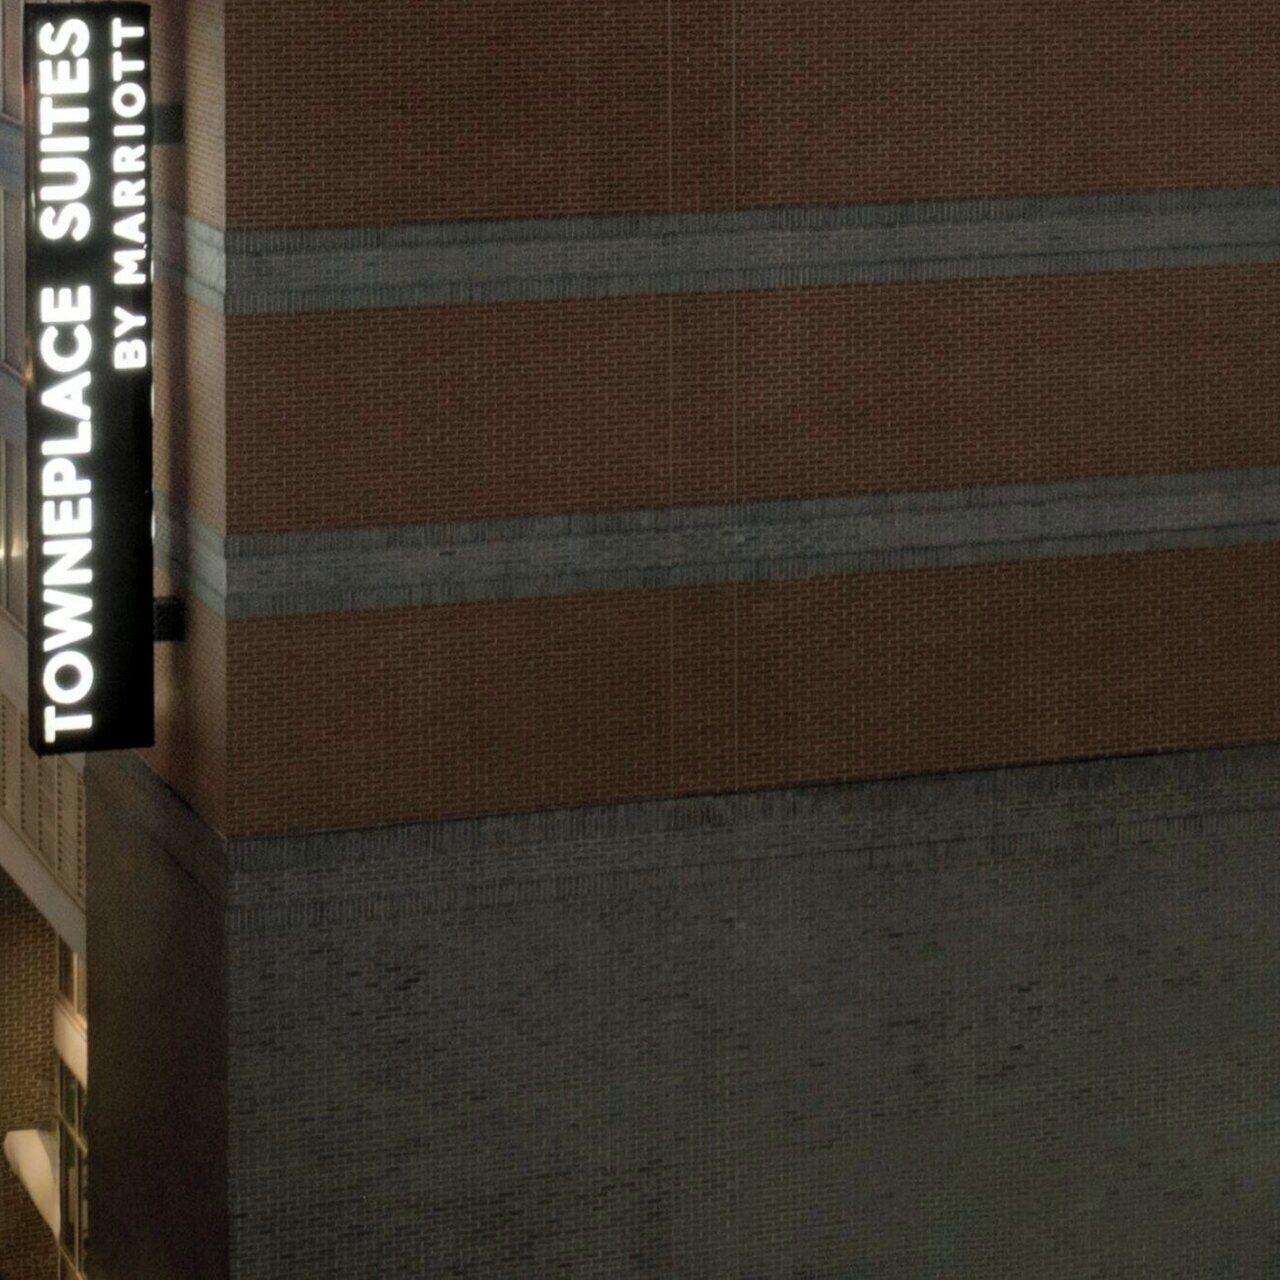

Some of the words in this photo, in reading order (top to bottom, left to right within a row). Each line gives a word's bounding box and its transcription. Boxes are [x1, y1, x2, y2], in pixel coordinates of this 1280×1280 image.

[36, 17, 93, 242] SUITES
[110, 16, 148, 286] MARRIOTT
[111, 305, 148, 371] BY
[38, 283, 95, 744] TOWNEPLACE
